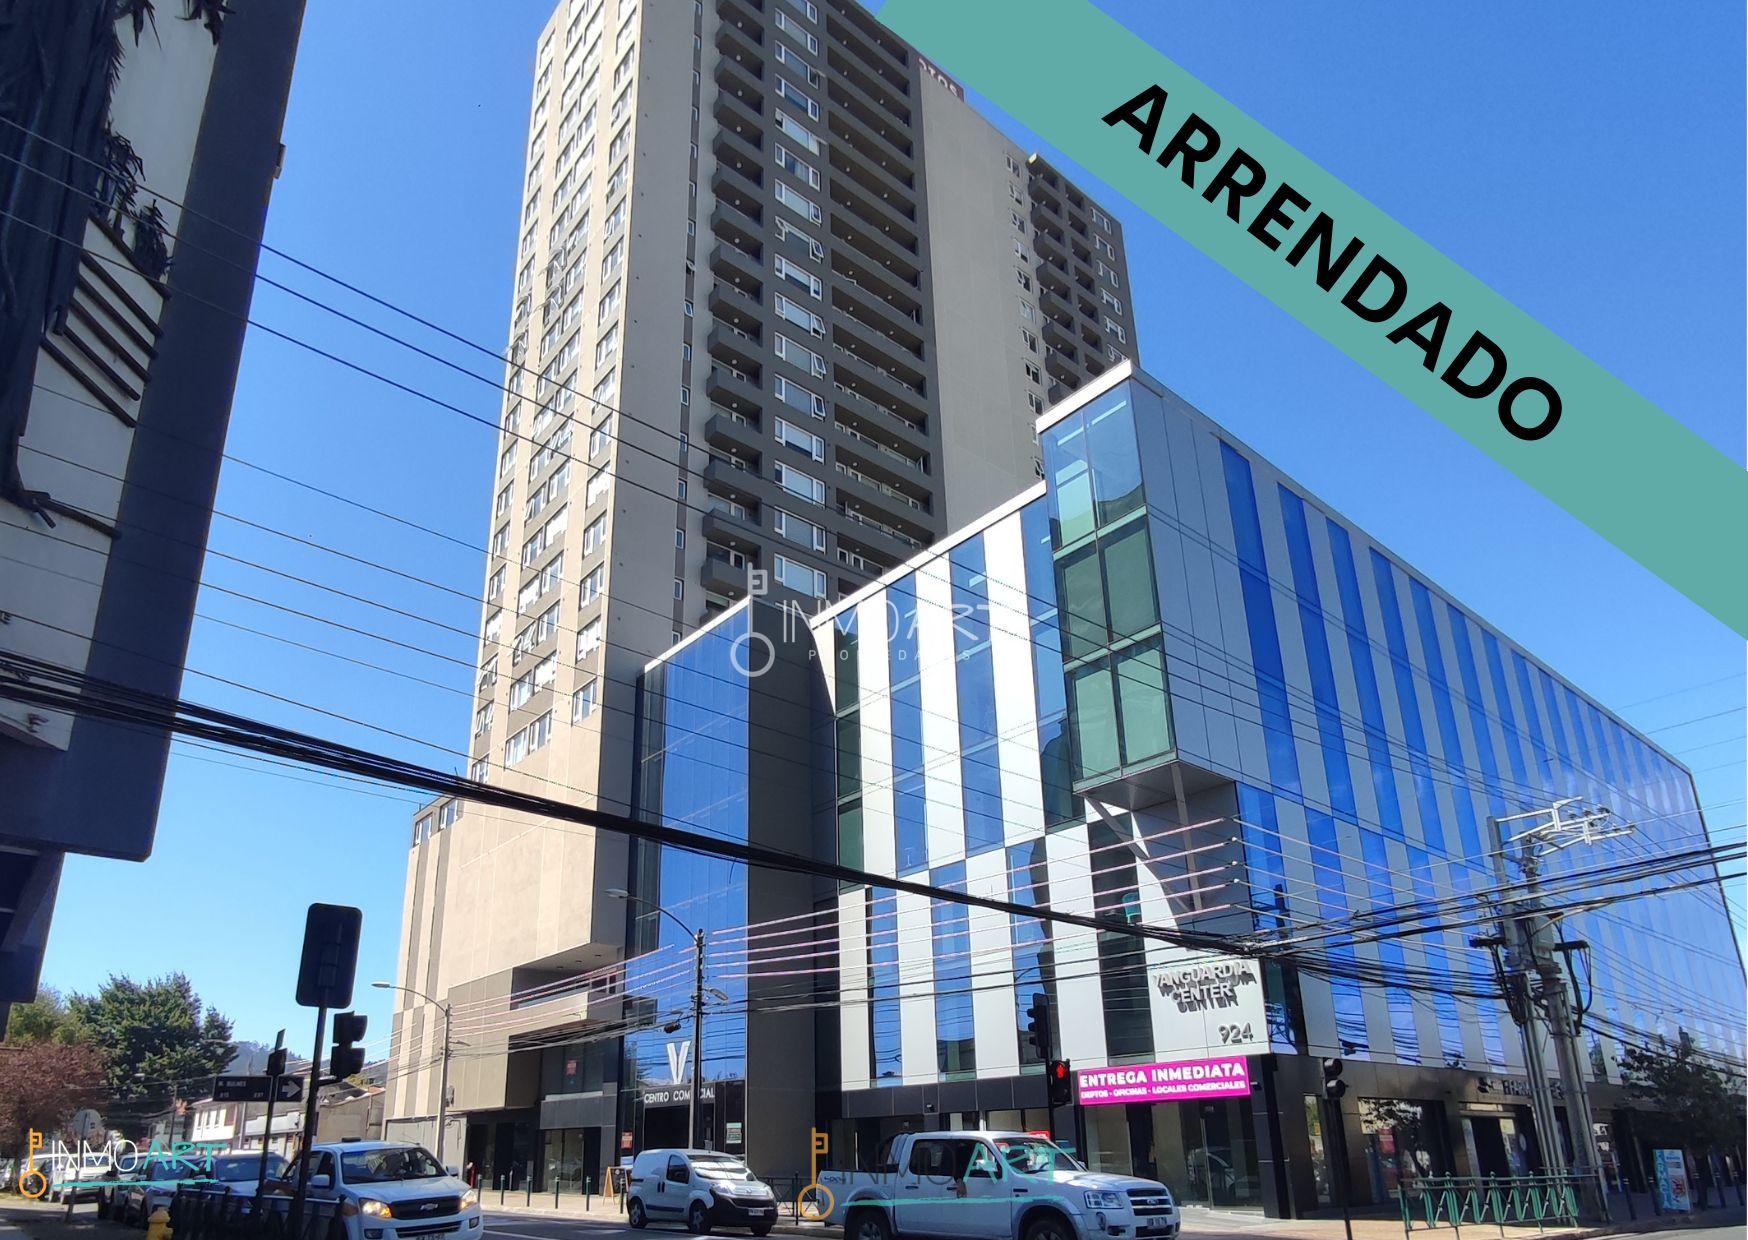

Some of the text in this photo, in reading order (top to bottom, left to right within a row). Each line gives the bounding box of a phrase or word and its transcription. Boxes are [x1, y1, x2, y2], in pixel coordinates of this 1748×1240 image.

[1153, 961, 1252, 987] VANGUARDIA
[1171, 983, 1235, 1003] CENTER
[1218, 1022, 1253, 1044] 924
[1079, 1062, 1245, 1088] ENTREGA INMEDIATA
[644, 1087, 715, 1103] CENTRO COMIAL
[1113, 1087, 1147, 1097] OFICINAS
[1151, 1083, 1187, 1094] LOCALES
[1188, 1080, 1246, 1092] COMERCIALES
